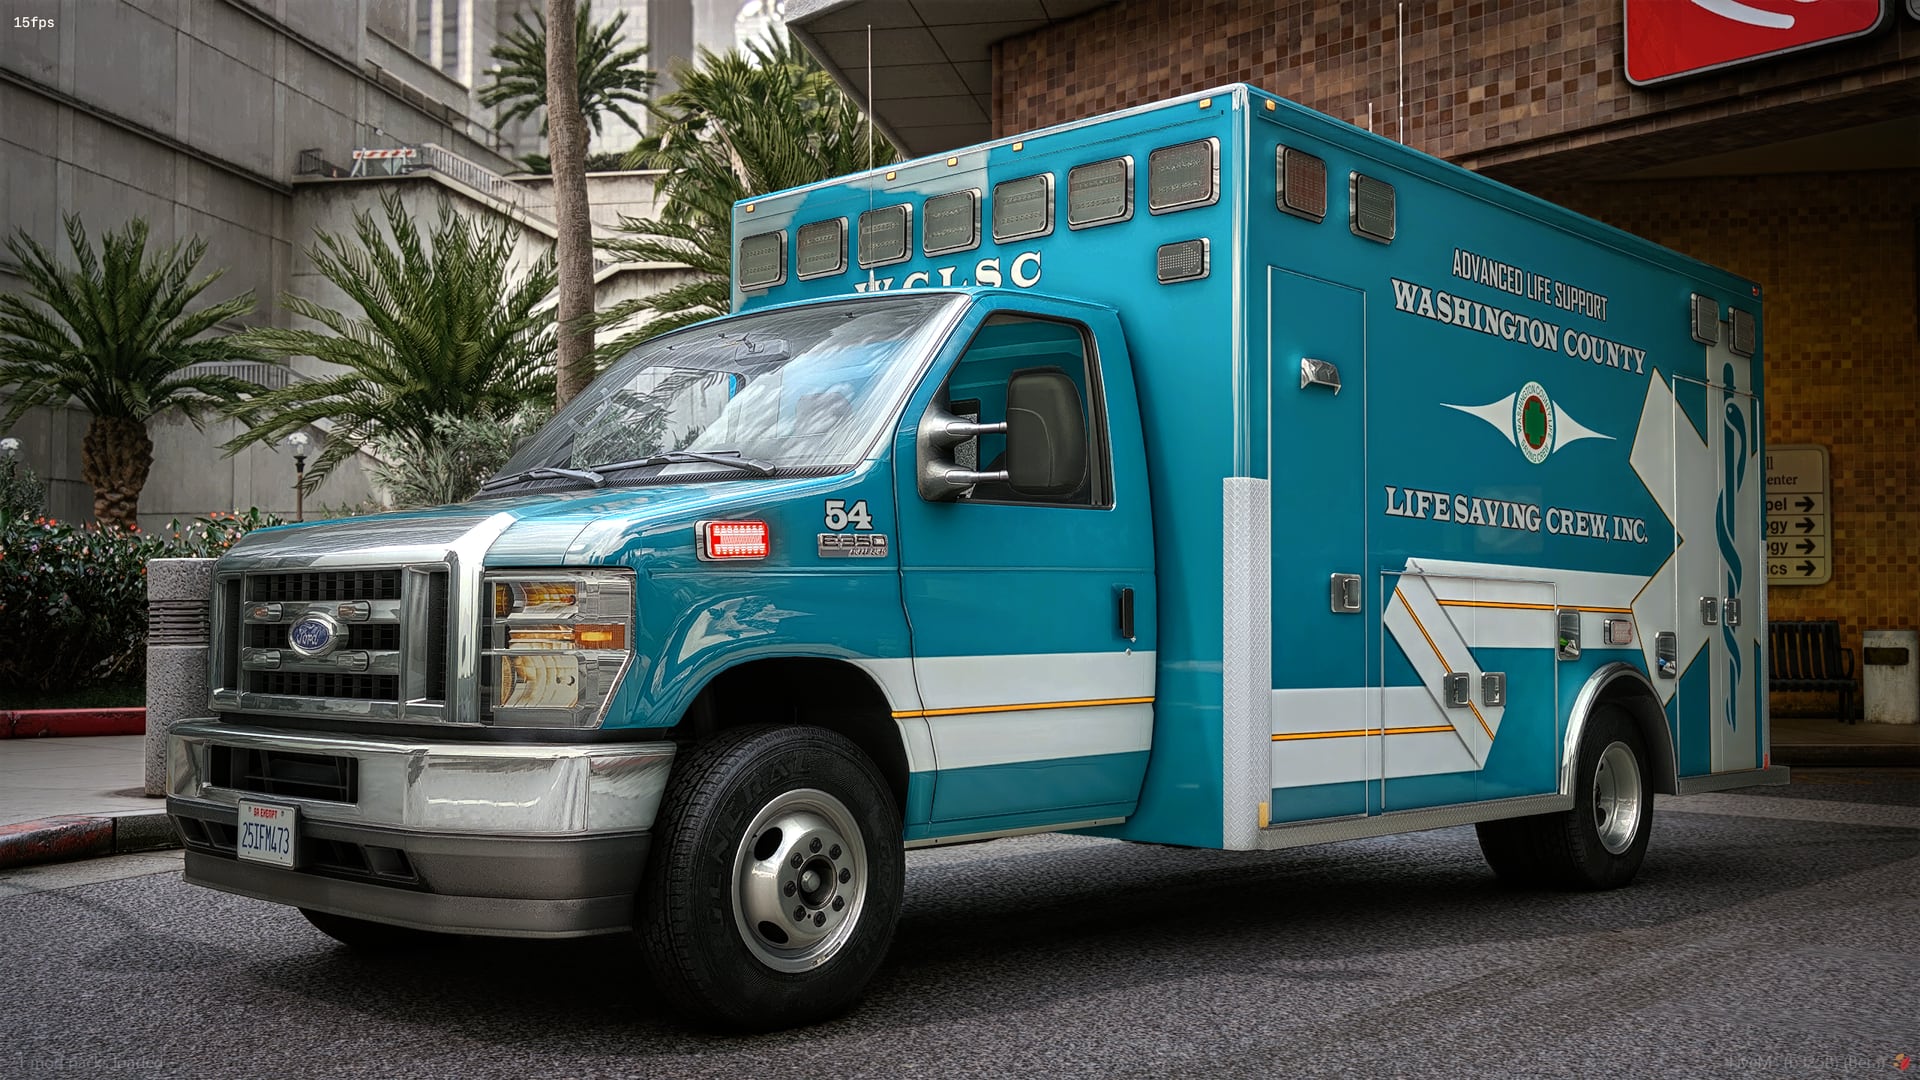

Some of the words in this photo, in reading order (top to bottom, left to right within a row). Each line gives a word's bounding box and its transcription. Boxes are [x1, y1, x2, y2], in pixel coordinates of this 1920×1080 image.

[1452, 248, 1523, 296] ADVANCED
[1526, 272, 1552, 305] LIFE
[1554, 280, 1608, 322] SUPPORT
[1390, 278, 1560, 351] WASHINGTON
[1563, 328, 1647, 375] COUNTY
[1766, 474, 1799, 486] enter
[824, 499, 874, 531] 54
[1384, 486, 1450, 521] LIFE
[1454, 494, 1542, 533] SAVING
[1545, 507, 1610, 543] CREW,
[1612, 516, 1649, 544] INC.
[1766, 497, 1788, 512] pel
[241, 821, 290, 855] 25IFM473
